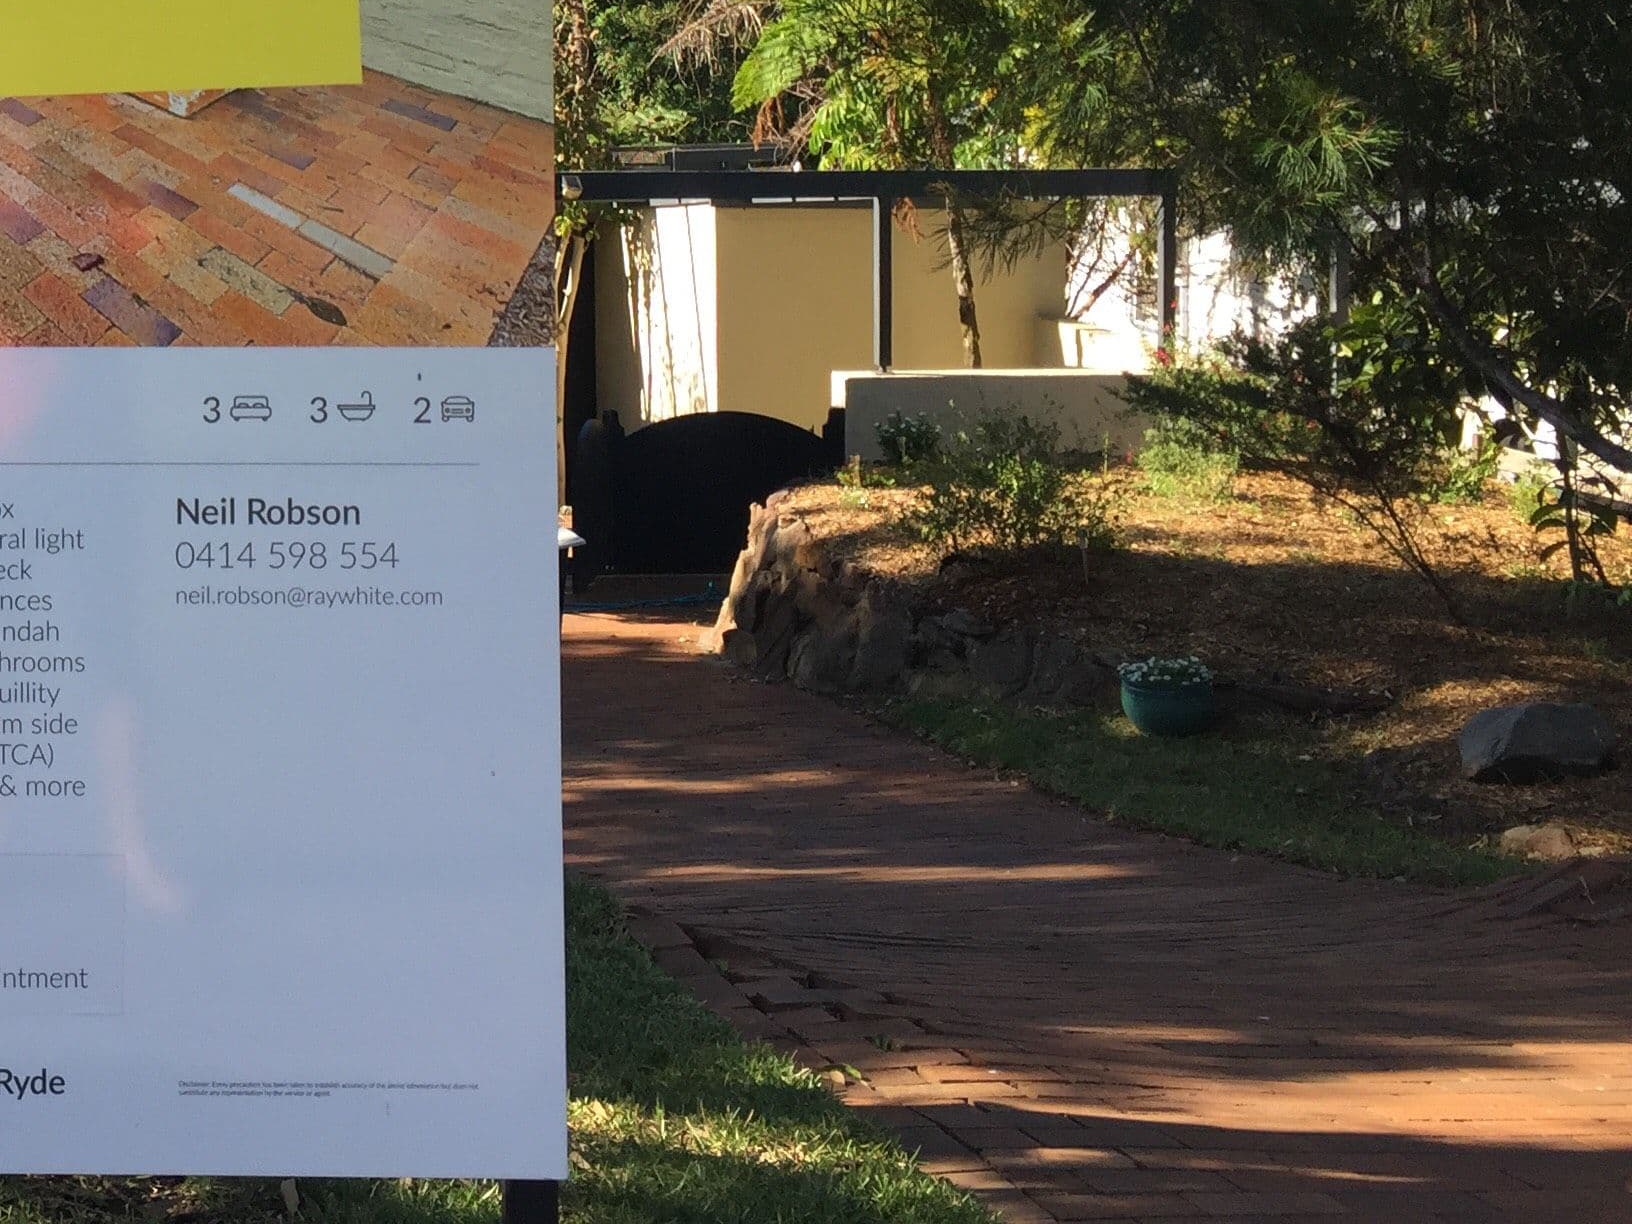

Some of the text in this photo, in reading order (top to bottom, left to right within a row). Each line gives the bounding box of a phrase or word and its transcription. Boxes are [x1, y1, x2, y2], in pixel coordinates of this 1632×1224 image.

[202, 396, 432, 424] 3 3 2
[176, 497, 361, 526] Neil Robson
[35, 527, 85, 555] light
[175, 541, 400, 570] 0414 598 554
[175, 585, 443, 609] neil.robson@raywhite.com
[31, 712, 78, 735] side
[26, 780, 86, 797] more
